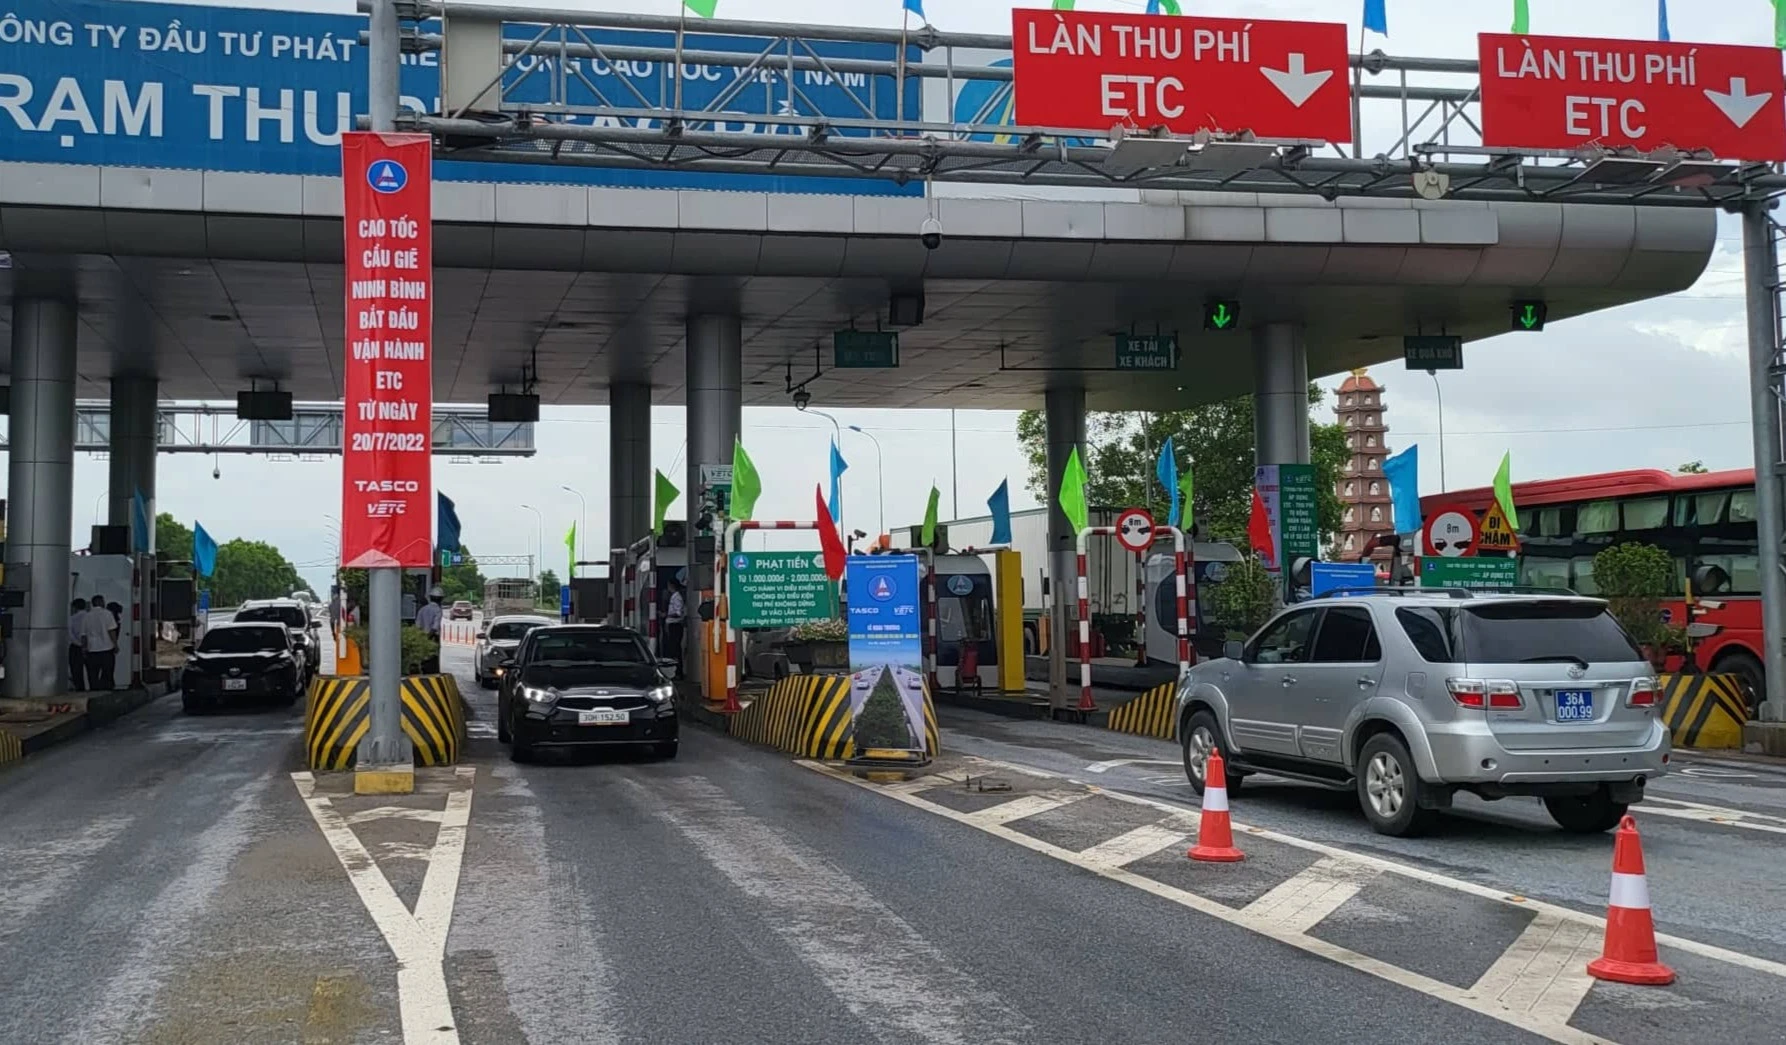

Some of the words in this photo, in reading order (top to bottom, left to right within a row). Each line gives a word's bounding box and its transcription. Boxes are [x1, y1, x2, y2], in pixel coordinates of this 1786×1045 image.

[84, 24, 127, 49] TY
[139, 19, 206, 53] ĐẦU
[218, 31, 263, 57] TƯ
[272, 32, 357, 62] PHÁT
[1028, 14, 1102, 56] LÀN
[1111, 25, 1182, 60] THU
[1194, 23, 1253, 63] PHÍ
[1497, 39, 1566, 81] LÀN
[1573, 51, 1636, 84] THU
[1645, 48, 1698, 86] PHÍ
[1101, 74, 1185, 119] ETC
[193, 84, 351, 147] THU
[1565, 95, 1647, 139] ETC
[358, 219, 386, 239] CAO
[389, 214, 418, 239] TỐC
[363, 243, 391, 268] CẦU
[394, 247, 418, 269] GIẼ
[352, 279, 386, 299] NINH
[390, 277, 426, 300] BÌNH
[359, 304, 386, 329] BẮT
[388, 305, 418, 330] ĐẦU
[352, 338, 380, 363] VẬN
[384, 338, 425, 360] HÀNH
[376, 371, 403, 390] ETC
[358, 399, 376, 421] TỪ
[378, 398, 419, 421] NGÀY
[352, 433, 425, 451] 20/7/2022
[355, 480, 419, 493] TASCO
[367, 500, 407, 517] VETC
[1446, 523, 1460, 533] 8m
[756, 559, 783, 571] PHẠT
[787, 555, 809, 569] TIỀN
[1565, 692, 1584, 705] 36A
[1558, 705, 1593, 719] 000.99
